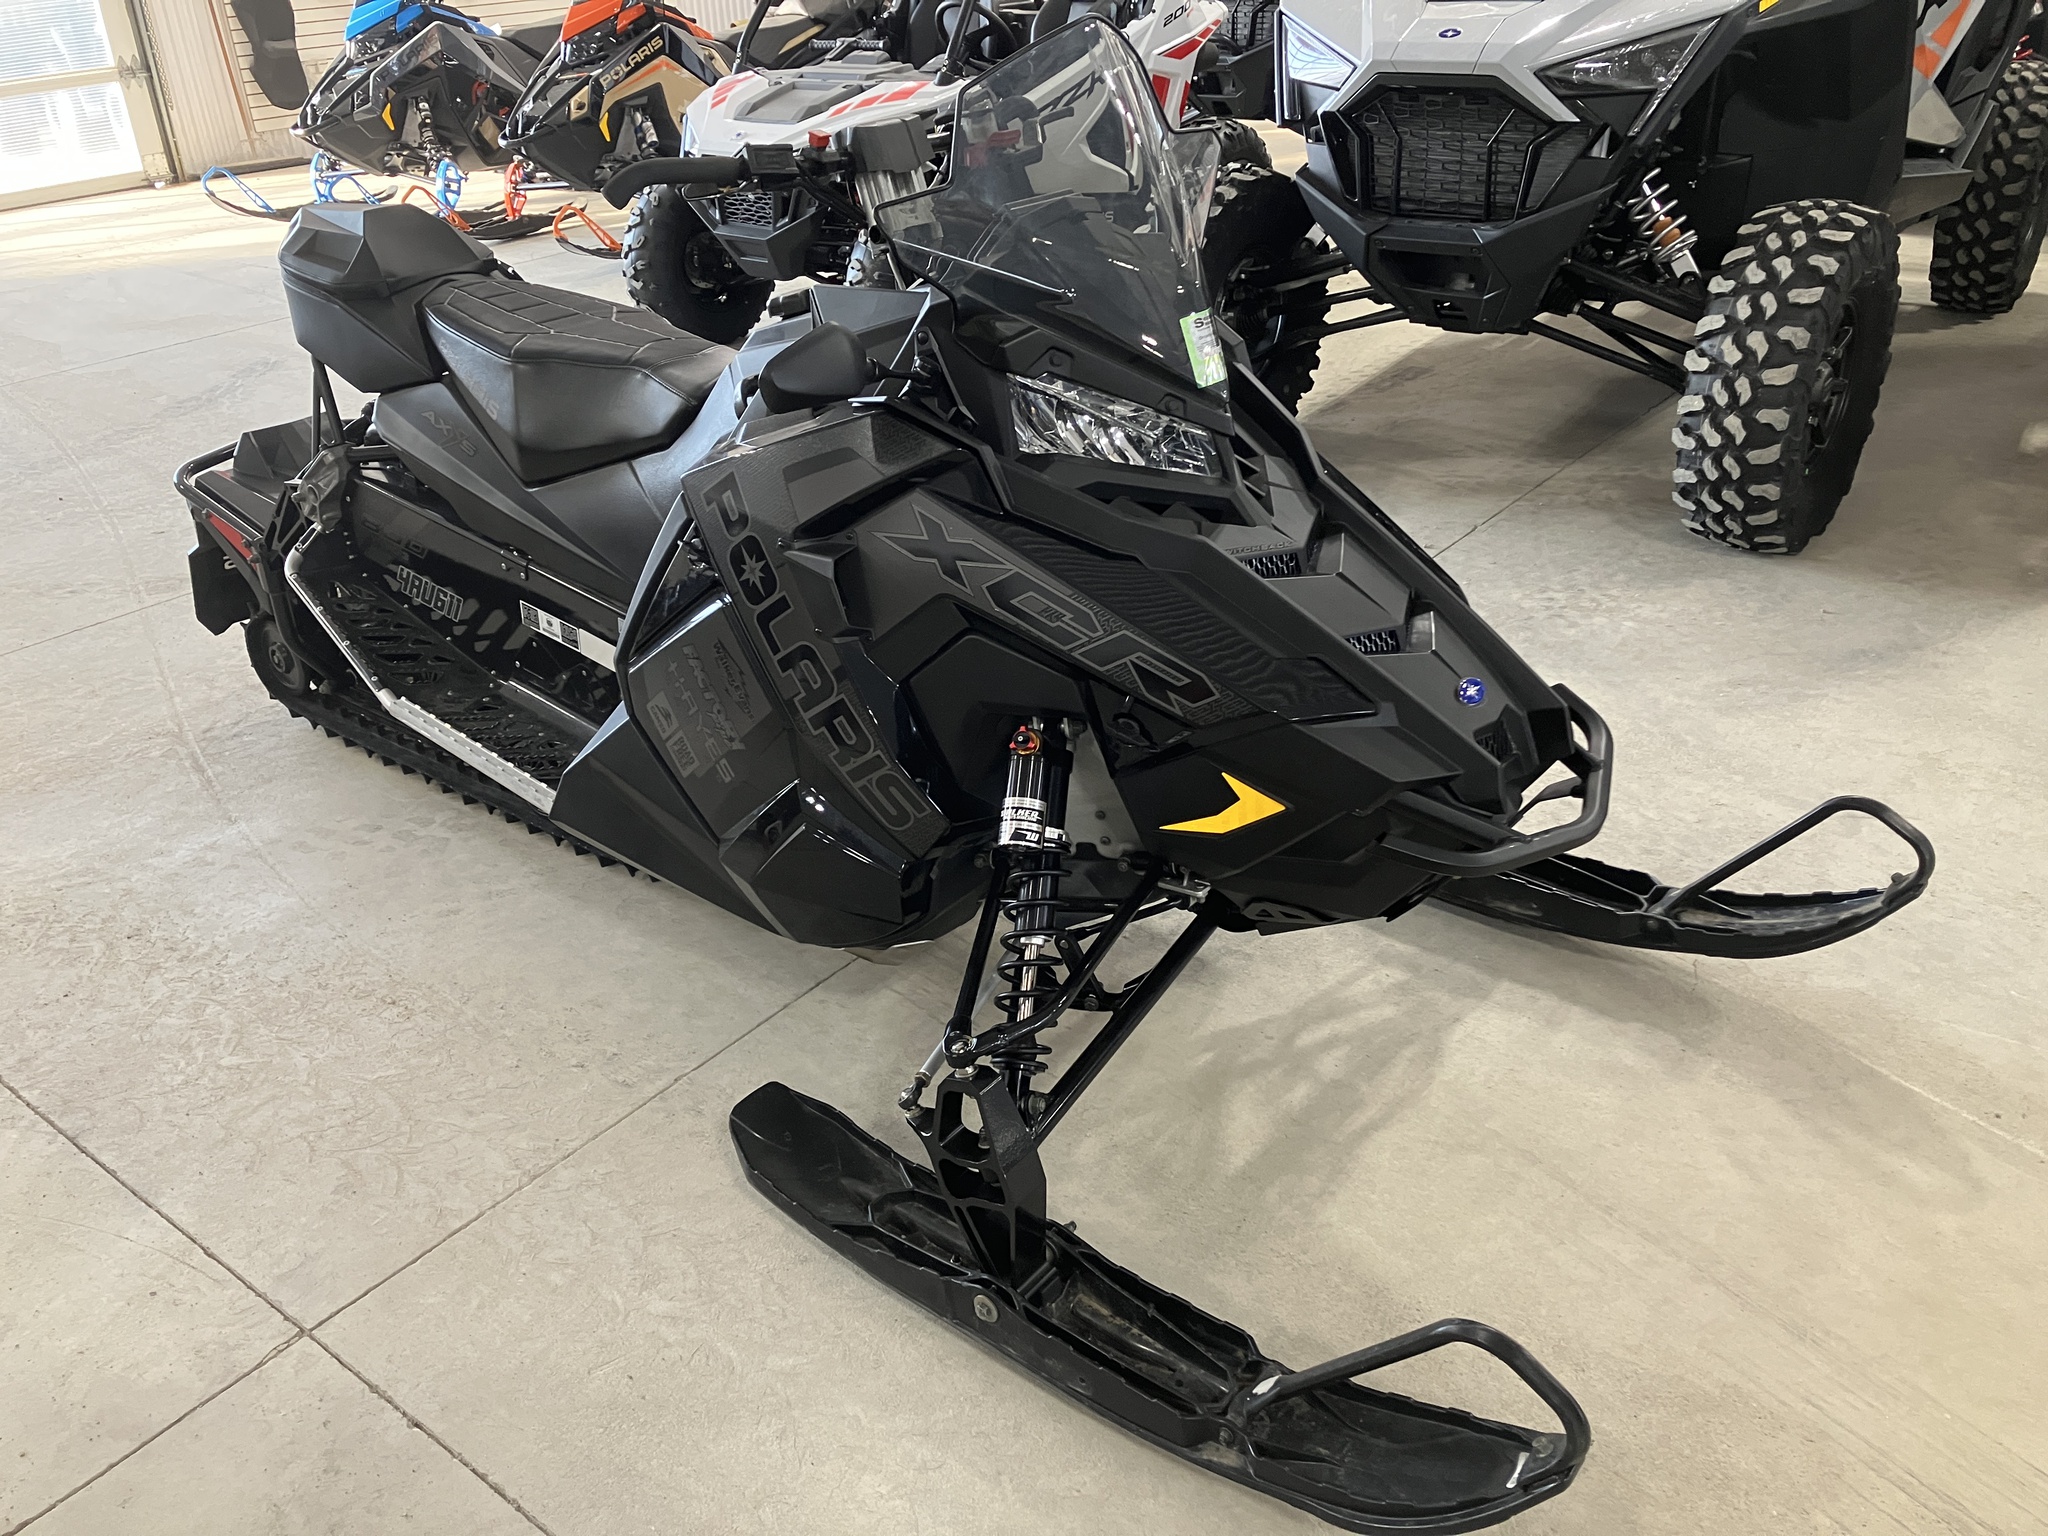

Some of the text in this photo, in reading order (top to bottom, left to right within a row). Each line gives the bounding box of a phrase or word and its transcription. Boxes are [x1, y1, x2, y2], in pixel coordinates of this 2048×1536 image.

[599, 35, 664, 90] POLARIS
[870, 504, 1221, 717] XCR
[1225, 541, 1293, 555] WITCHBACK
[701, 472, 932, 832] POLARIS
